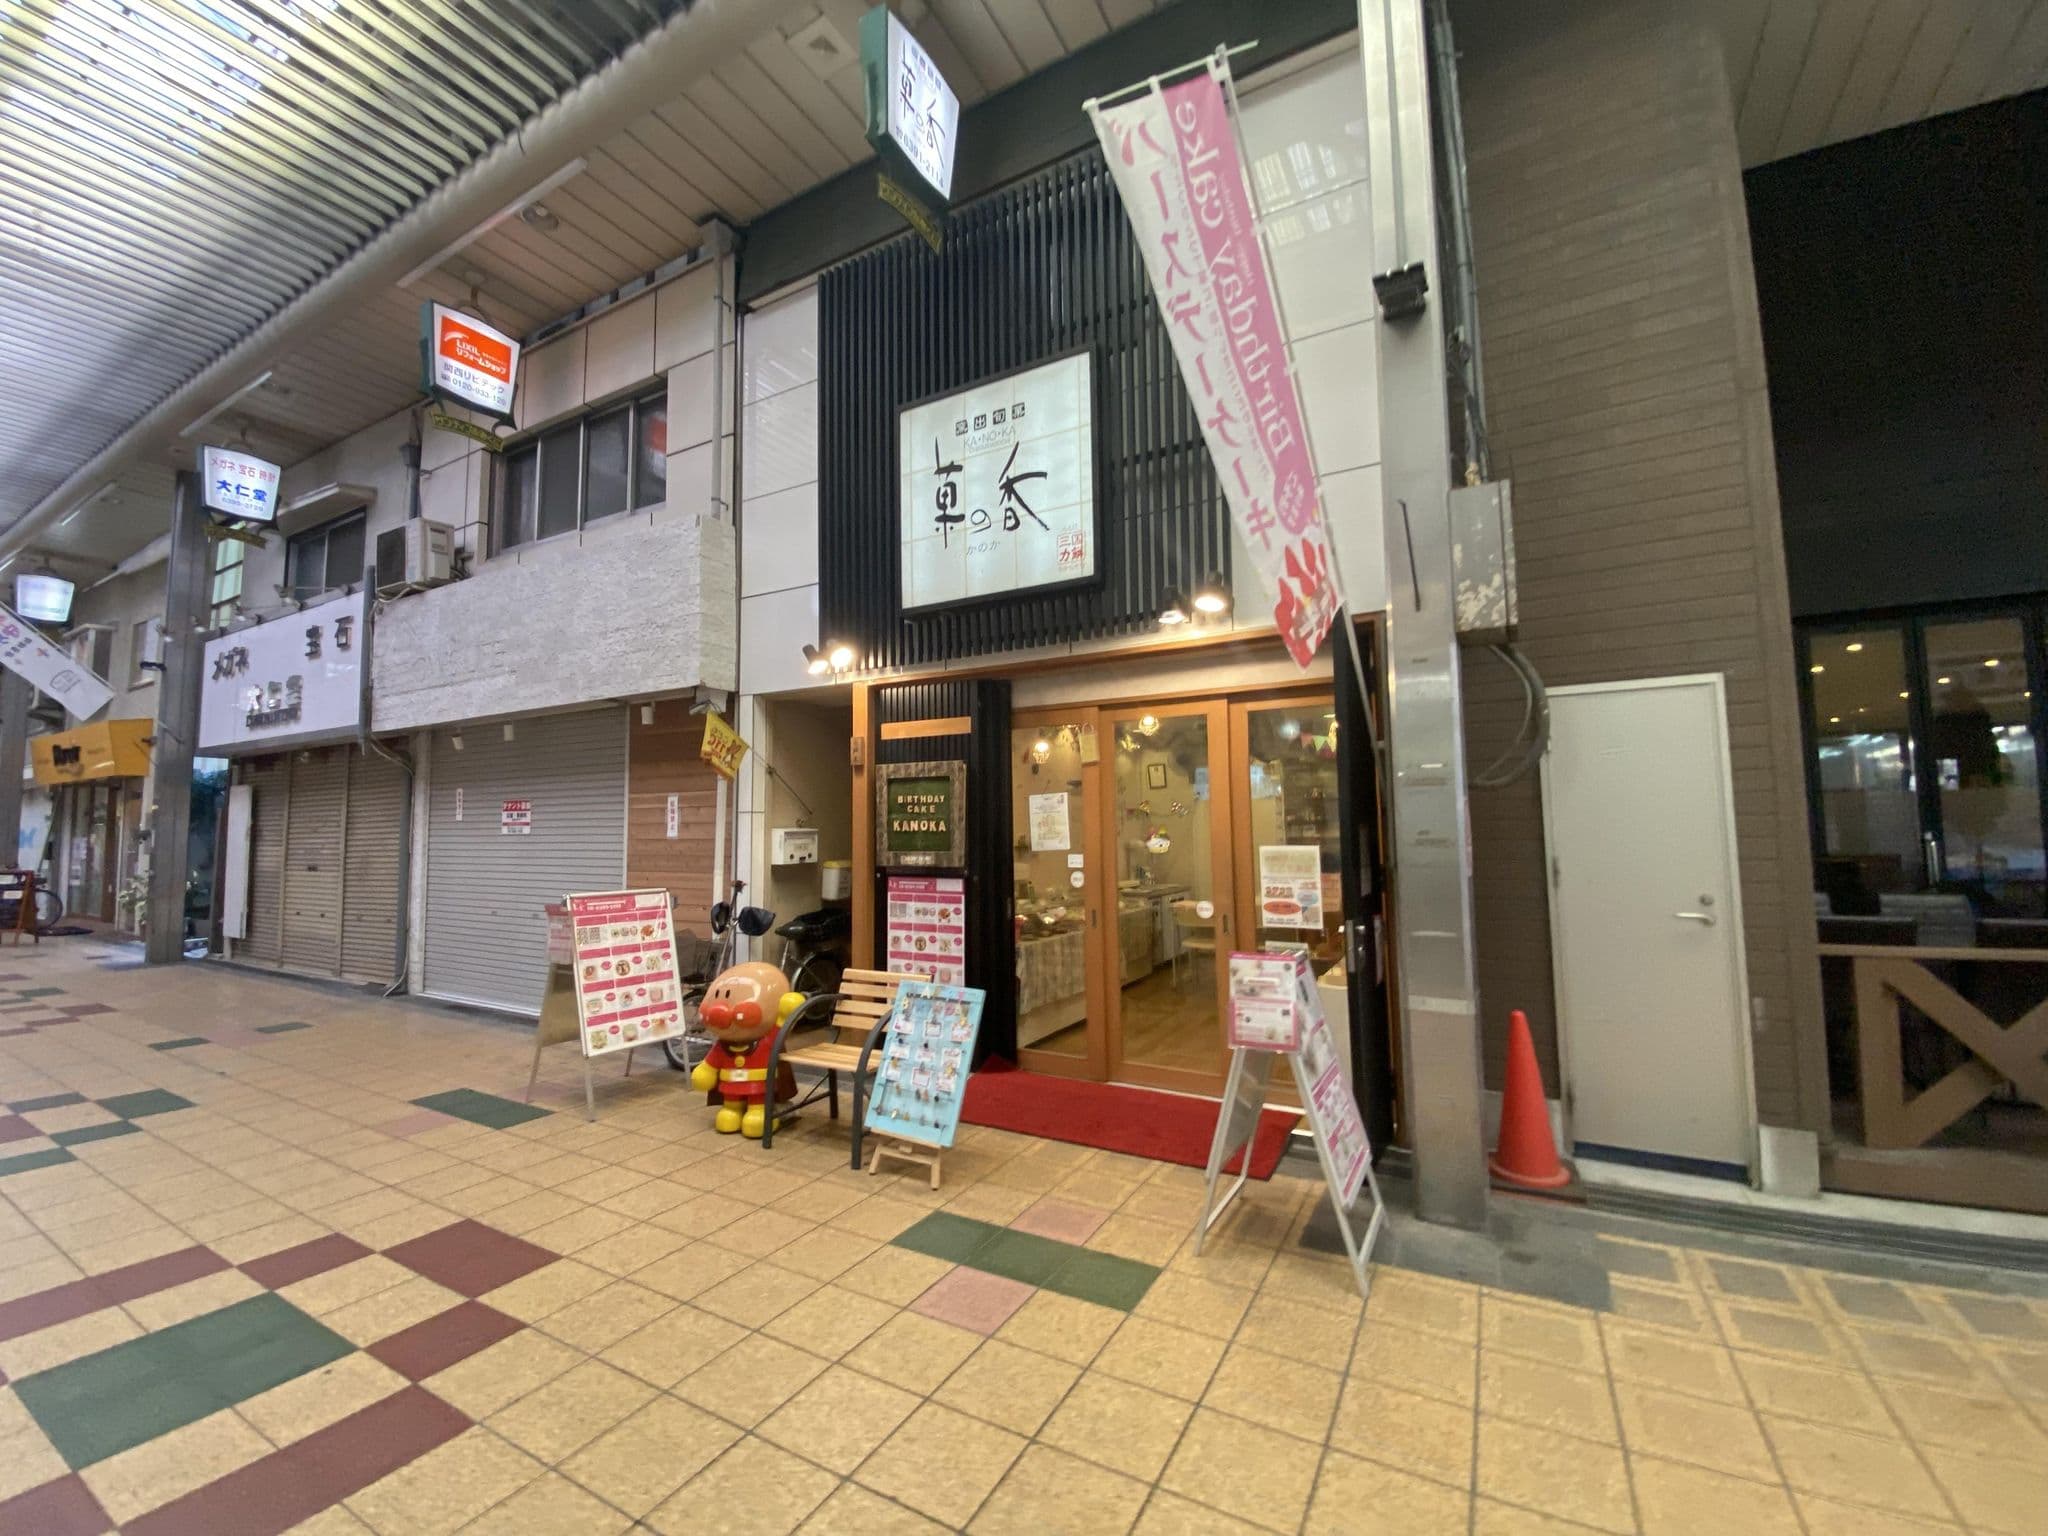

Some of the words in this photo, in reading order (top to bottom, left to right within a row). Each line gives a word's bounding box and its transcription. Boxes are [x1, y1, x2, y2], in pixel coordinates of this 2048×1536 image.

[456, 338, 481, 357] LIXIL
[897, 794, 945, 804] BIRTHDAY
[906, 805, 936, 814] CAKE
[893, 819, 946, 833] KANOKA
